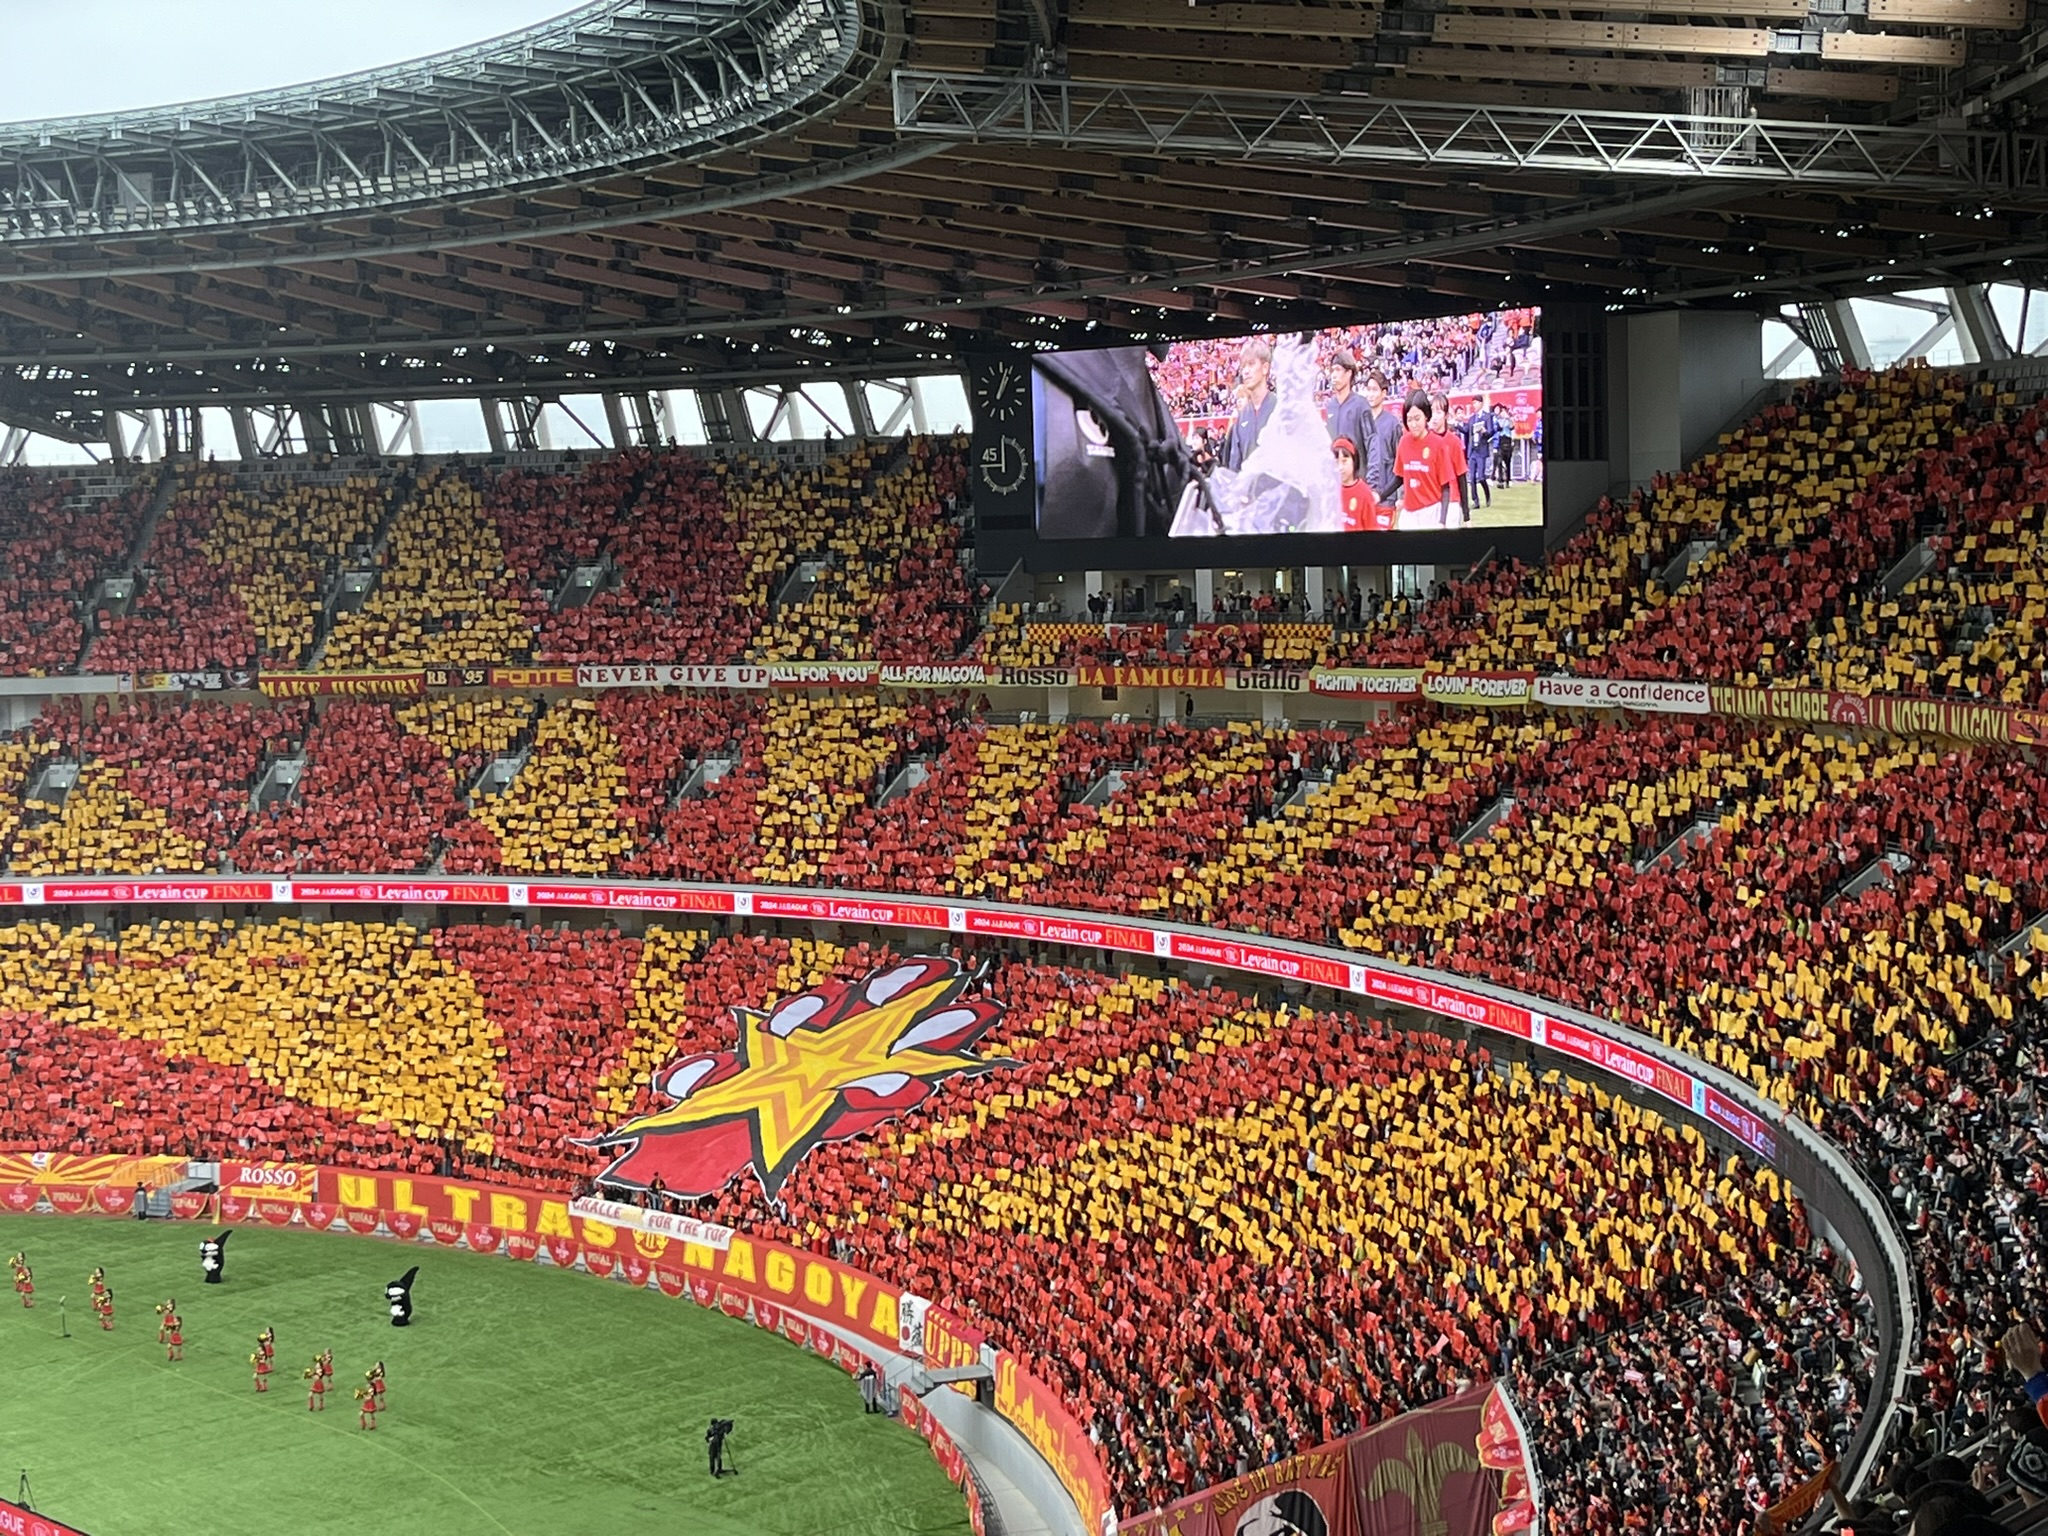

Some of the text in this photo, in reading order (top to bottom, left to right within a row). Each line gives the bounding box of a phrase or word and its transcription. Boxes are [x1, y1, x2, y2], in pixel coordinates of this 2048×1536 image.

[982, 447, 998, 461] 45
[492, 668, 574, 684] FONTE
[580, 665, 767, 684] NEVER GIVE UP
[771, 666, 799, 682] ALL
[800, 666, 831, 682] FOR
[881, 664, 986, 684] ALL FOR NAGOYA
[1078, 666, 1225, 687] LA FAMIGLIA
[1236, 669, 1300, 691] Giallo
[1360, 675, 1417, 693] TOGETHER
[259, 681, 321, 698] MAKE
[331, 678, 420, 695] HISTORY
[1471, 677, 1527, 697] FOREVER
[1539, 681, 1584, 696] Have
[1590, 684, 1600, 697] a
[134, 885, 181, 898] Levain
[183, 889, 208, 899] CUP
[212, 885, 263, 898] FINAL
[378, 885, 422, 900] Levain
[424, 889, 448, 900] CUP
[452, 886, 500, 900] FINAL
[536, 892, 554, 900] 2024
[609, 891, 651, 906] Levain
[654, 896, 676, 908] CUP
[680, 894, 726, 910] FINAL
[830, 902, 870, 919] Levain
[872, 908, 893, 921] CUP
[897, 908, 942, 925] FINAL
[974, 918, 990, 927] 2024
[1040, 921, 1078, 939] Levain
[1080, 928, 1102, 943] CUP
[1106, 929, 1146, 950] FINAL
[1240, 949, 1279, 972] Levain
[1280, 958, 1300, 976] CUP
[1302, 960, 1343, 984] FINAL
[1432, 989, 1466, 1014] Levain
[1488, 1004, 1526, 1033] FINAL
[1656, 1066, 1688, 1101] FINAL
[240, 1167, 297, 1186] ROSSO
[649, 1214, 672, 1229] FOR
[677, 1219, 699, 1237] THE
[704, 1225, 728, 1242] TOP
[338, 1174, 899, 1340] ULTRAS NAGOYA
